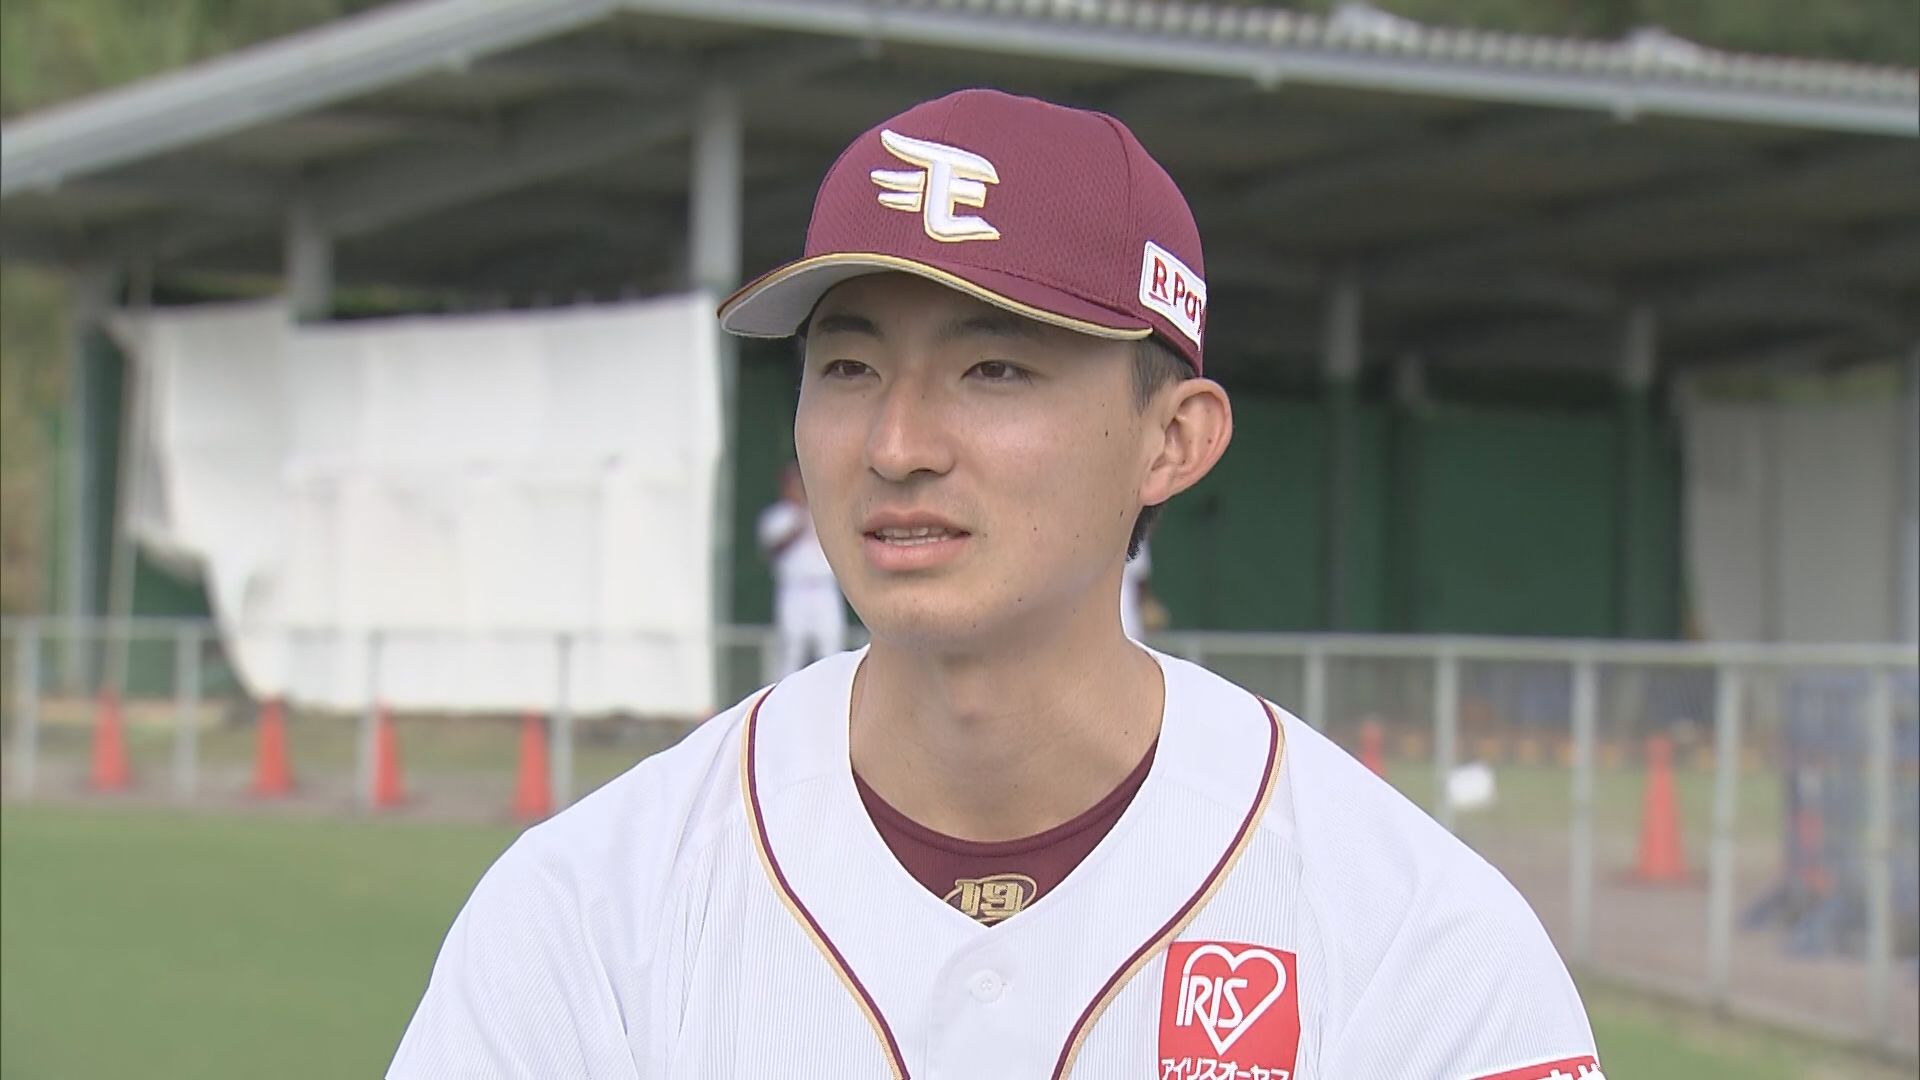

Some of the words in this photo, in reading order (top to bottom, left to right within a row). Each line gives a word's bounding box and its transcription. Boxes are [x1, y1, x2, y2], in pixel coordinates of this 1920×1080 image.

[1150, 256, 1170, 303] R
[960, 883, 1024, 917] 19
[1176, 975, 1248, 1028] IRIS
